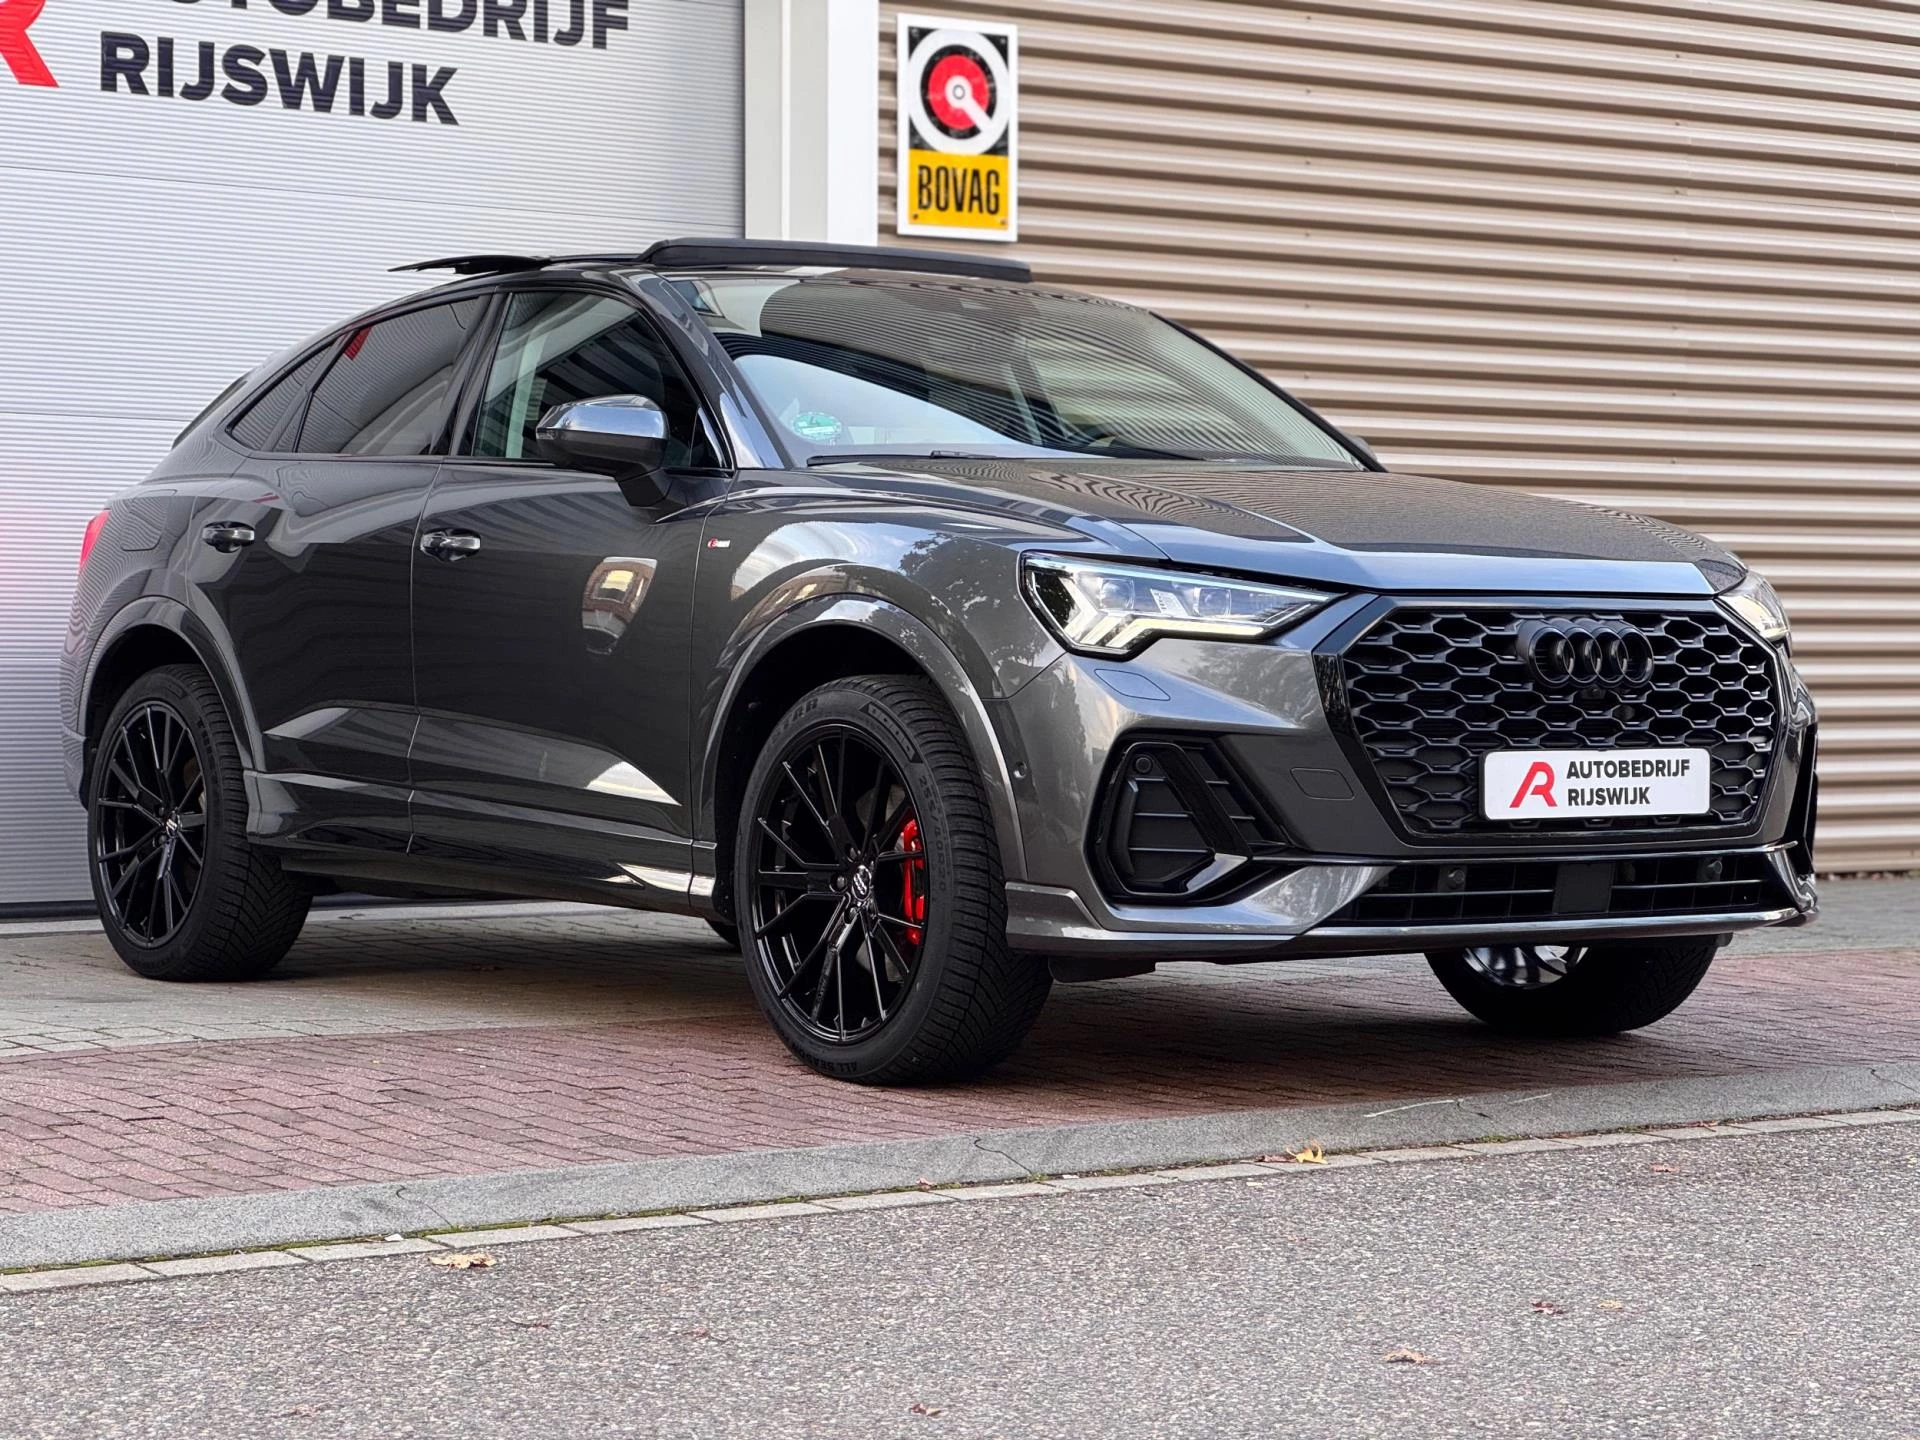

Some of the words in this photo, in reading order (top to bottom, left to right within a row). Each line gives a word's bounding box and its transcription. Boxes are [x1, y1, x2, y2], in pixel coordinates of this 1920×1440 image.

[101, 31, 459, 126] RIJSWIJK
[918, 165, 1000, 215] BOVAG
[1566, 759, 1690, 779] AUTOBEDRIJF
[1567, 787, 1650, 806] RIJSWIJK
